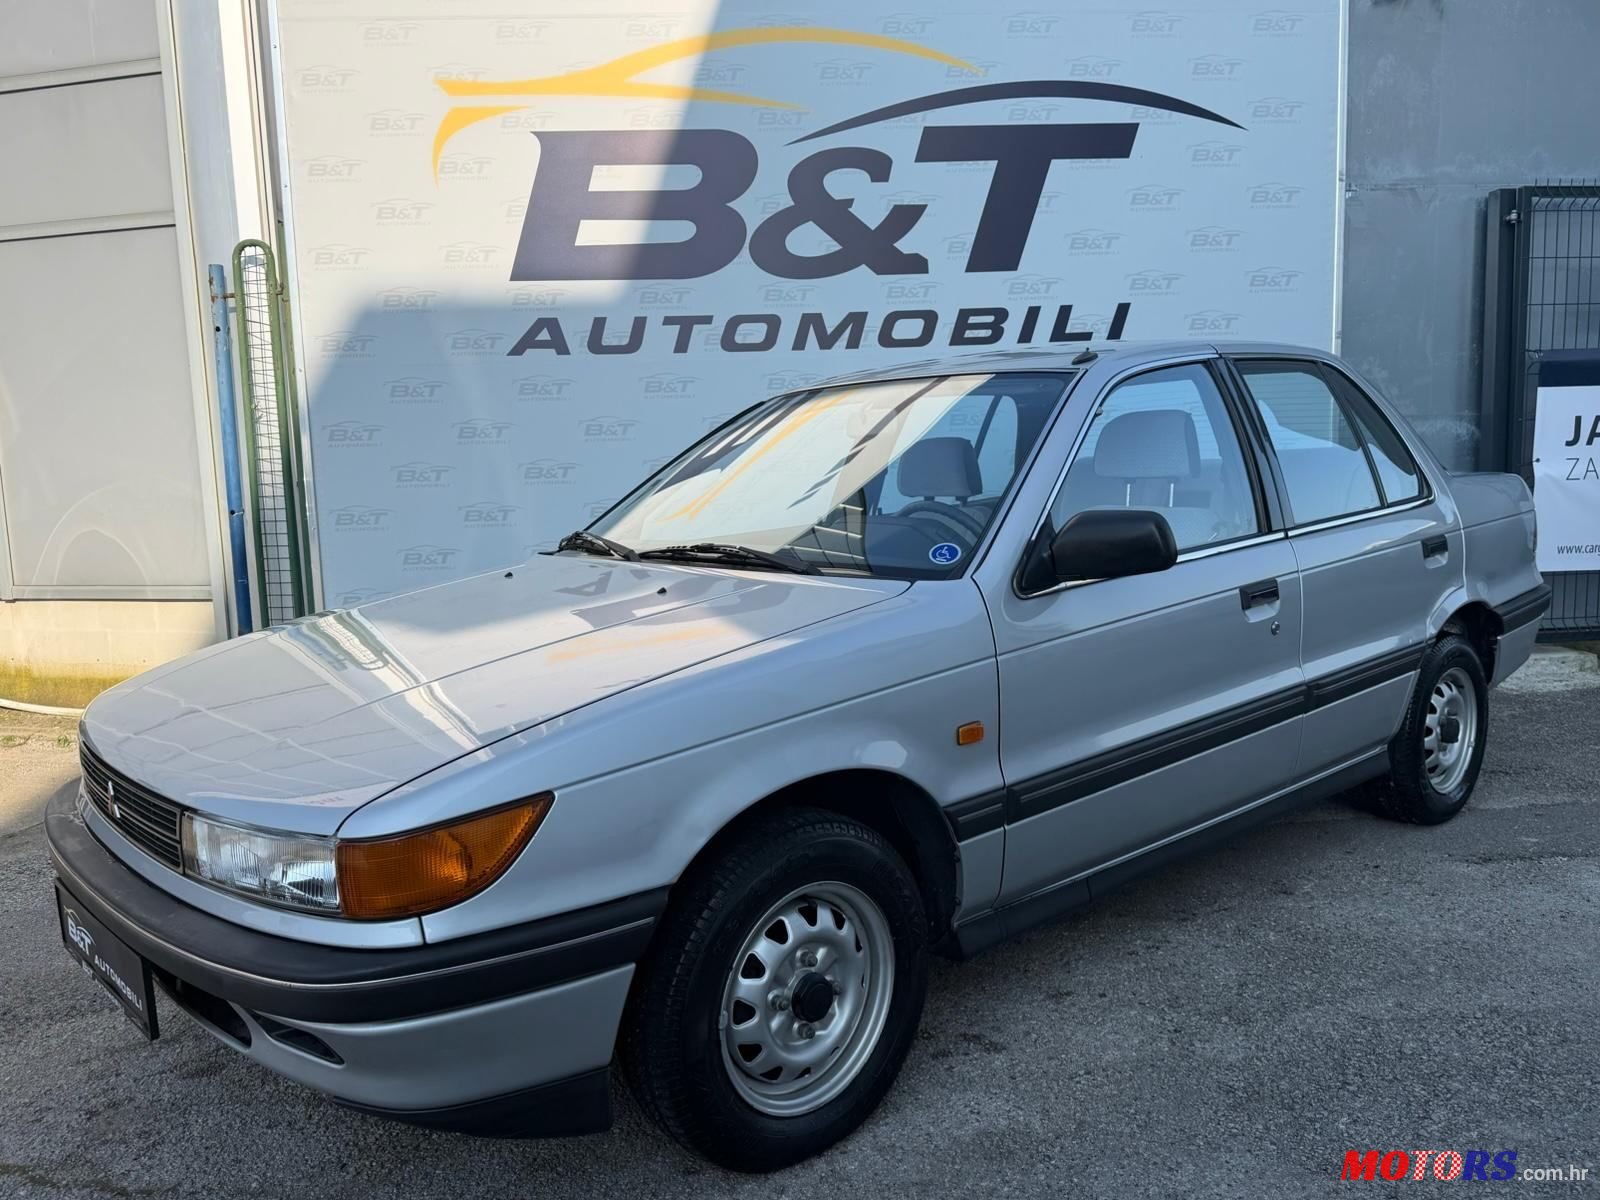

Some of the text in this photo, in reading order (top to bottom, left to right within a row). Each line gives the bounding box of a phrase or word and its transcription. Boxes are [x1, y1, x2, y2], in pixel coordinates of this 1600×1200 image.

[495, 24, 550, 39] B&T
[881, 19, 934, 34] B&T
[1006, 19, 1059, 33] B&T
[1131, 18, 1182, 32] B&T
[1252, 18, 1303, 32] B&T
[363, 26, 418, 40] B&T
[691, 67, 745, 81] B&T
[819, 65, 872, 79] B&T
[1069, 63, 1120, 77] B&T
[1192, 62, 1242, 76] B&T
[300, 73, 352, 87] B&T
[757, 111, 810, 125] B&T
[1007, 107, 1059, 121] B&T
[1252, 104, 1302, 118] B&T
[370, 117, 424, 131] B&T
[501, 115, 555, 129] B&T
[1191, 148, 1242, 162] B&T
[307, 163, 361, 177] B&T
[439, 161, 492, 174] B&T
[509, 123, 1139, 281] B&T
[1130, 192, 1181, 206] B&T
[1250, 190, 1300, 204] B&T
[376, 206, 430, 220] B&T
[1069, 236, 1121, 250] B&T
[1190, 233, 1240, 247] B&T
[314, 252, 368, 265] B&T
[444, 248, 496, 262] B&T
[1008, 281, 1058, 295] B&T
[1129, 277, 1180, 291] B&T
[1248, 274, 1299, 288] B&T
[639, 291, 691, 304] B&T
[763, 288, 815, 302] B&T
[886, 284, 937, 298] B&T
[382, 294, 438, 308] B&T
[512, 292, 565, 306] B&T
[507, 303, 1131, 356] AUTOMOBILI
[1188, 317, 1238, 331] B&T
[321, 338, 375, 352] B&T
[451, 336, 505, 350] B&T
[390, 384, 443, 398] B&T
[518, 382, 571, 396] B&T
[644, 380, 696, 394] B&T
[328, 428, 382, 442] B&T
[457, 426, 510, 440] B&T
[584, 423, 636, 437] B&T
[396, 469, 449, 482] B&T
[523, 467, 576, 480] B&T
[1566, 457, 1599, 480] ZA
[335, 512, 388, 526] B&T
[463, 509, 516, 522] B&T
[402, 552, 456, 566] B&T
[94, 954, 143, 1011] AUTOMOBILI
